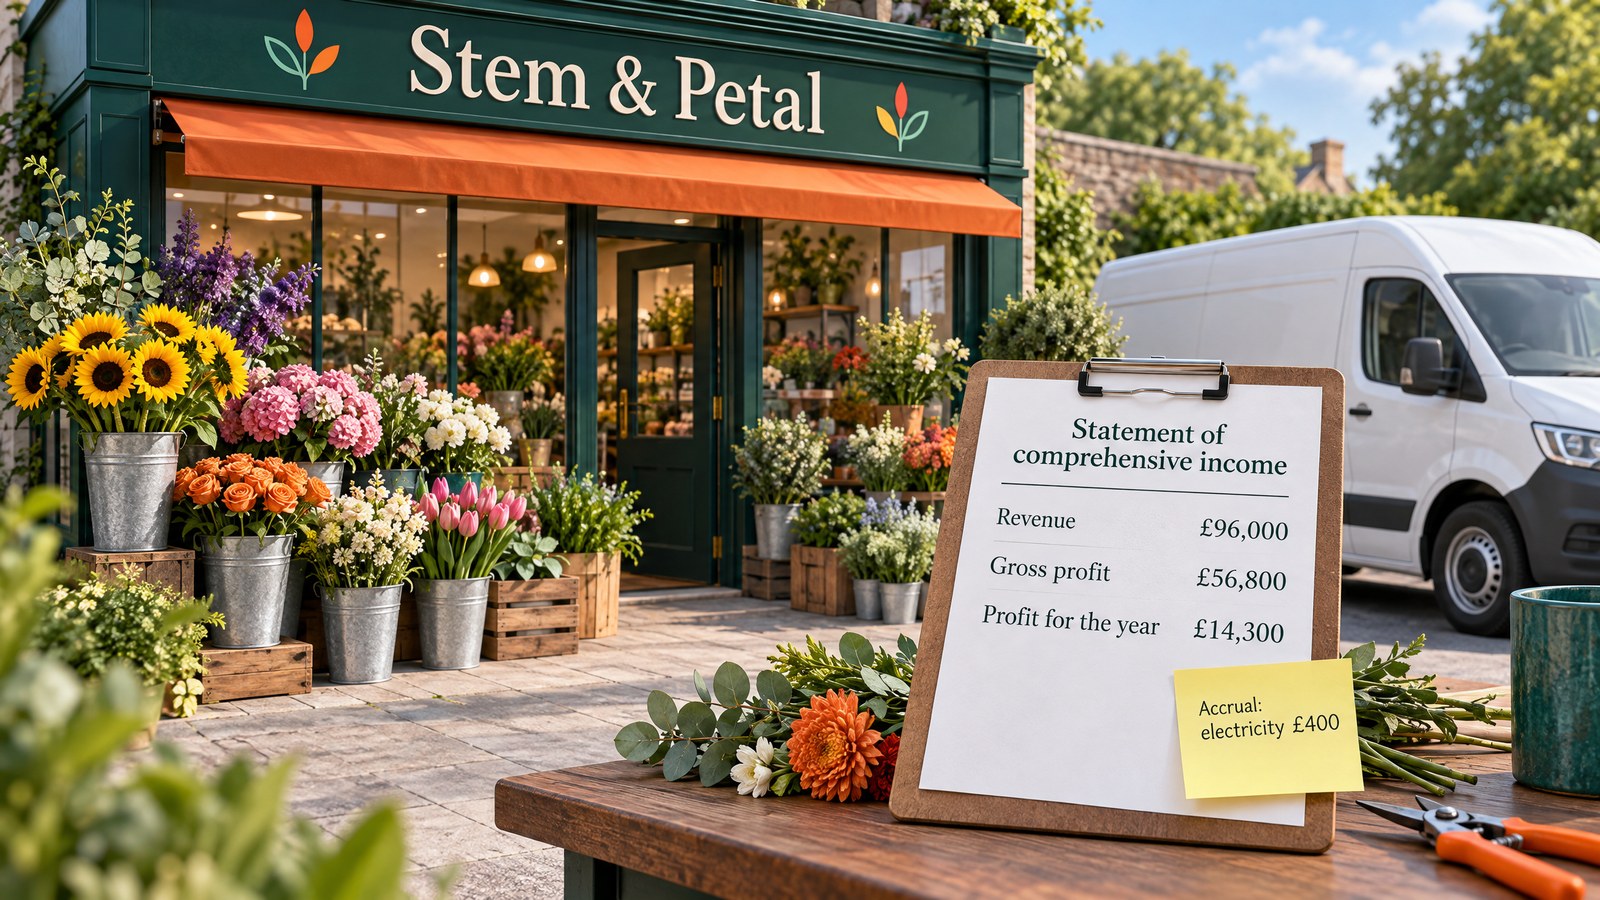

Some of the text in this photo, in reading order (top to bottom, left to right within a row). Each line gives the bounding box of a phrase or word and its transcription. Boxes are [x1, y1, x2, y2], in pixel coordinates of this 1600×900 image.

[410, 24, 825, 134] Stem & Petal
[1072, 418, 1227, 444] Statement of
[1013, 447, 1287, 475] comprehensive income
[997, 508, 1288, 542] Revenue £96,000
[991, 556, 1286, 592] Gross profit £56,800
[982, 605, 1284, 644] Profit for the year £14,300
[1199, 697, 1261, 716] Accrual:
[1202, 714, 1339, 740] electricity £400
